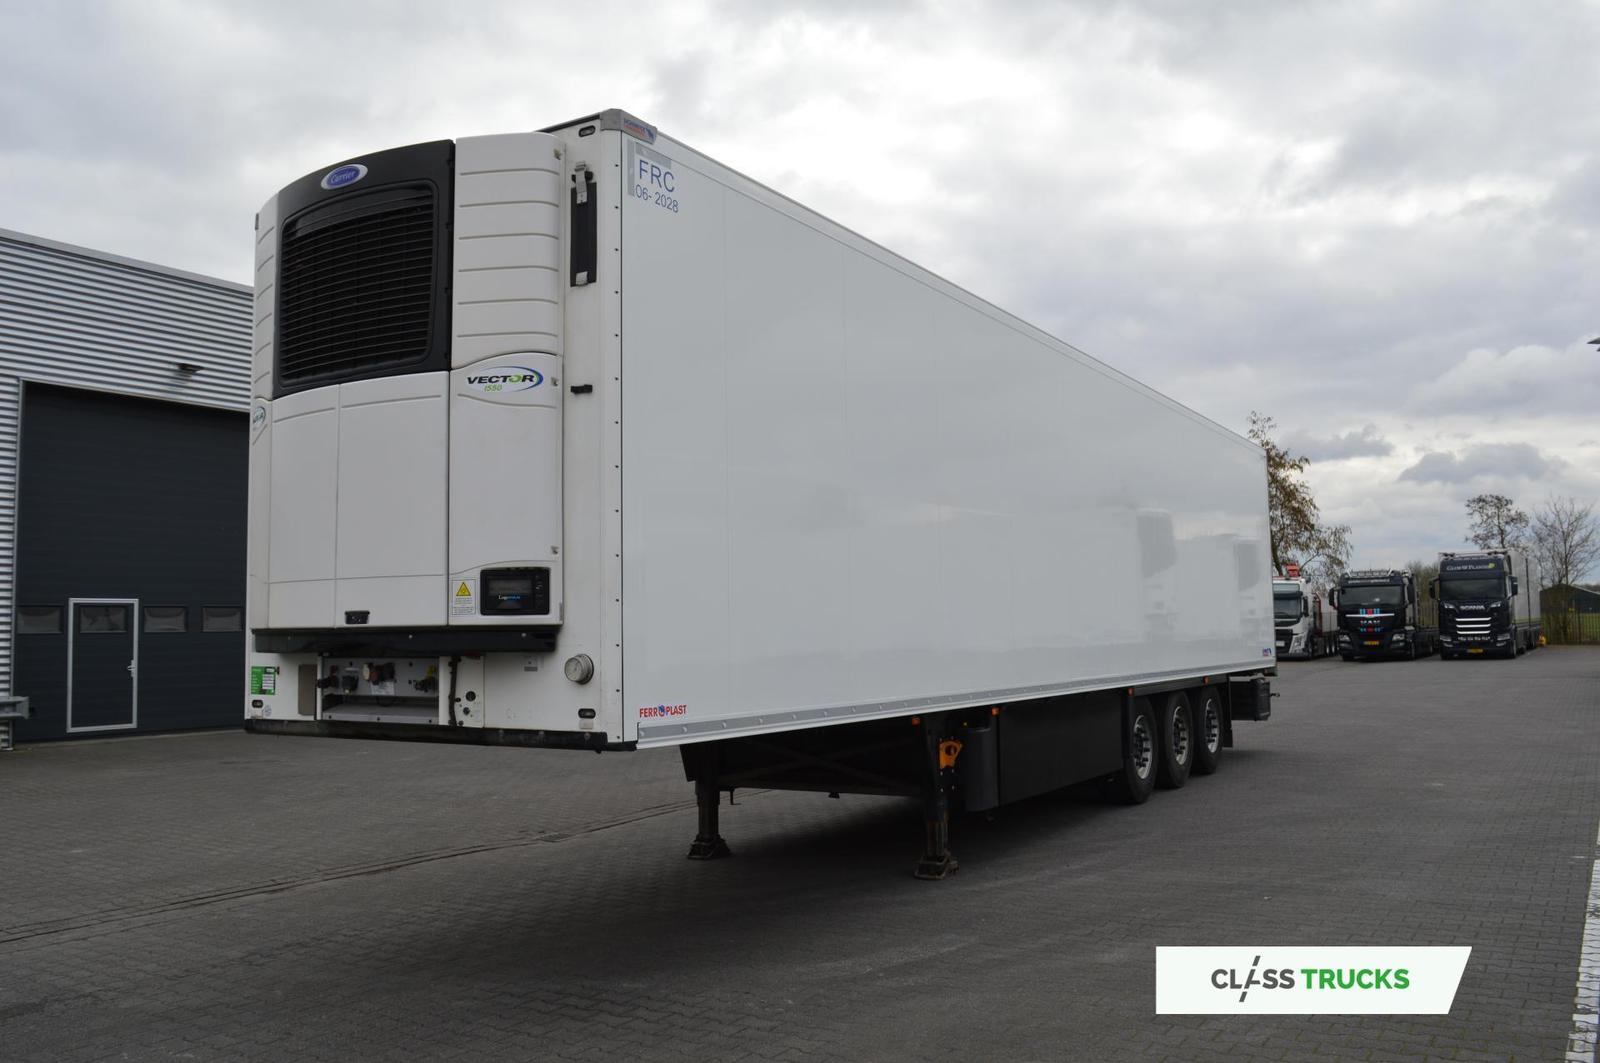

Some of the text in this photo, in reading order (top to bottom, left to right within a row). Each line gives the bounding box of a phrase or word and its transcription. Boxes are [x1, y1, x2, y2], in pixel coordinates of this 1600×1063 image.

[331, 169, 356, 183] Carrier
[639, 159, 675, 193] FRC
[654, 192, 679, 213] 2028
[467, 374, 535, 384] VECTOR
[639, 704, 687, 718] FERROPLAST
